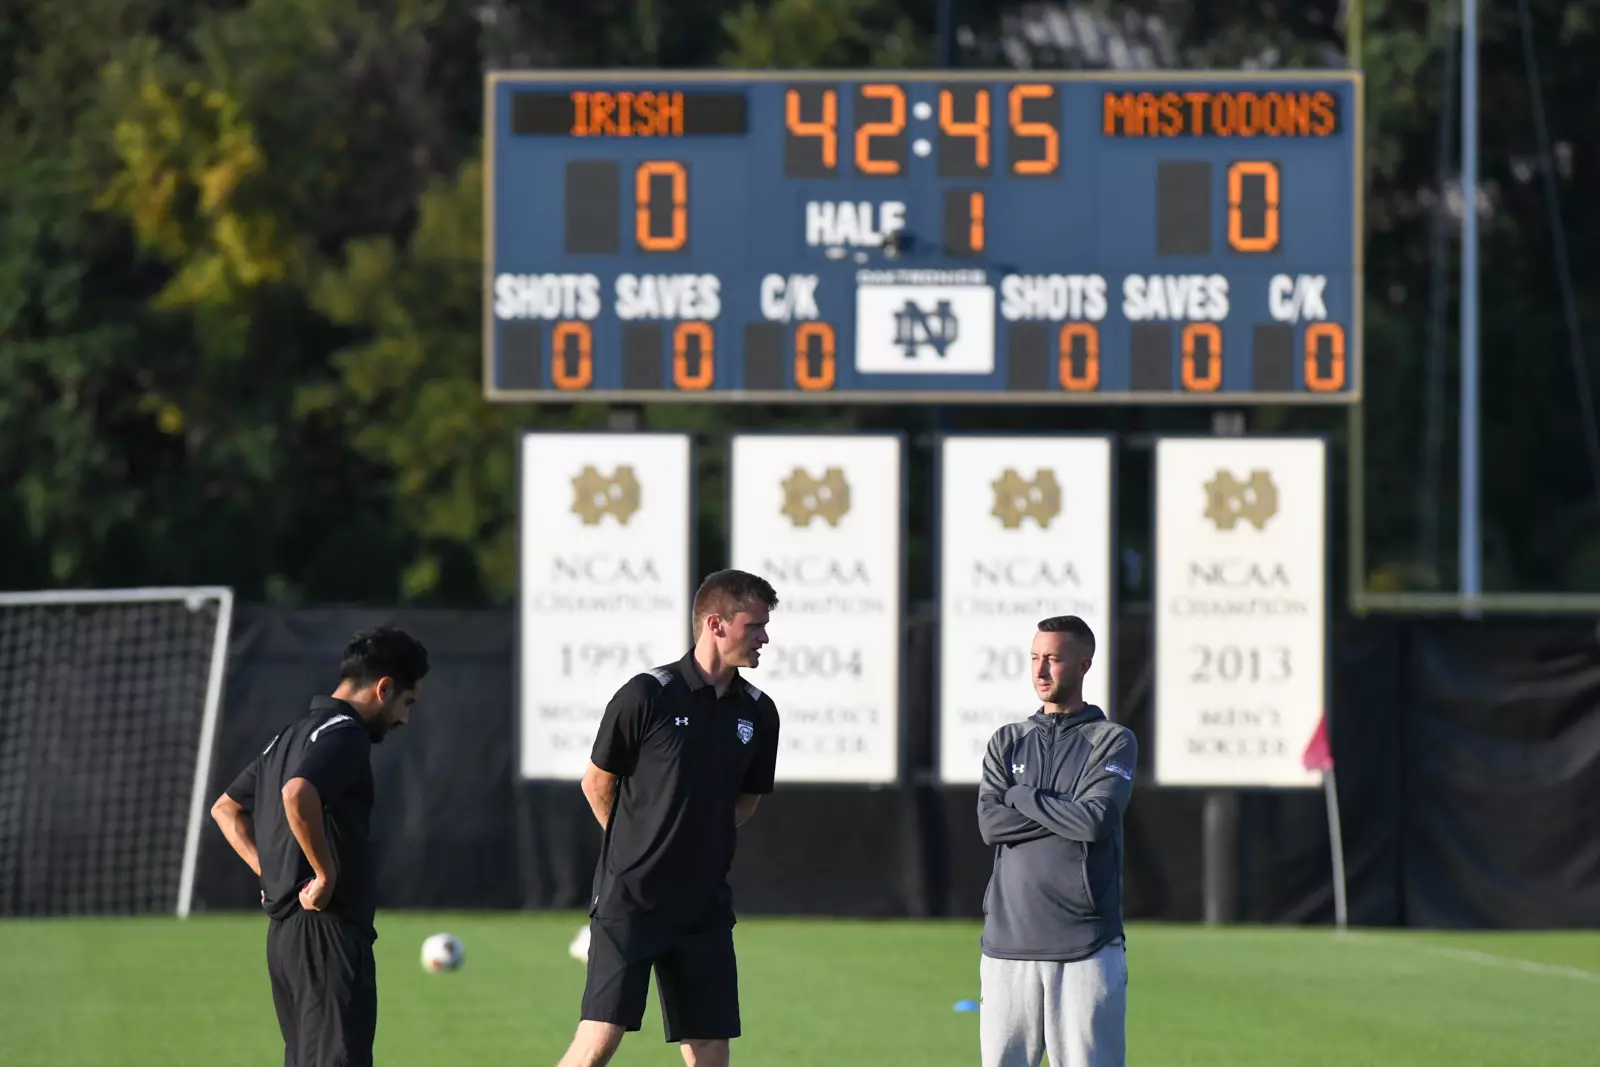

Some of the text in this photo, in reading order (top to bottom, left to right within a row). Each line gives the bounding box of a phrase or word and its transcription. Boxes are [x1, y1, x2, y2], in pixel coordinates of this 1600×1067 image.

[571, 91, 684, 137] IRISH
[1103, 91, 1336, 137] MASTODONS
[635, 160, 688, 252] 0
[806, 201, 906, 246] HALF
[969, 191, 985, 252] 1
[1227, 160, 1280, 253] 0
[493, 273, 601, 320] SHOTS
[615, 273, 721, 320] SAVES
[760, 273, 820, 322] C/K
[1001, 274, 1108, 321] SHOTS
[1122, 274, 1230, 321] SAVES
[1268, 274, 1328, 323] C/K
[552, 321, 593, 390] 0
[673, 322, 714, 390] 0
[795, 322, 836, 390] 0
[1059, 322, 1100, 391] 0
[1181, 322, 1223, 391] 0
[1304, 322, 1346, 392] 0
[551, 554, 663, 585] NCAA
[761, 555, 872, 586] NCAA
[971, 557, 1083, 589] NCAA
[1186, 558, 1292, 590] NCAA
[766, 645, 865, 682] 2004
[1188, 643, 1294, 686] 2013
